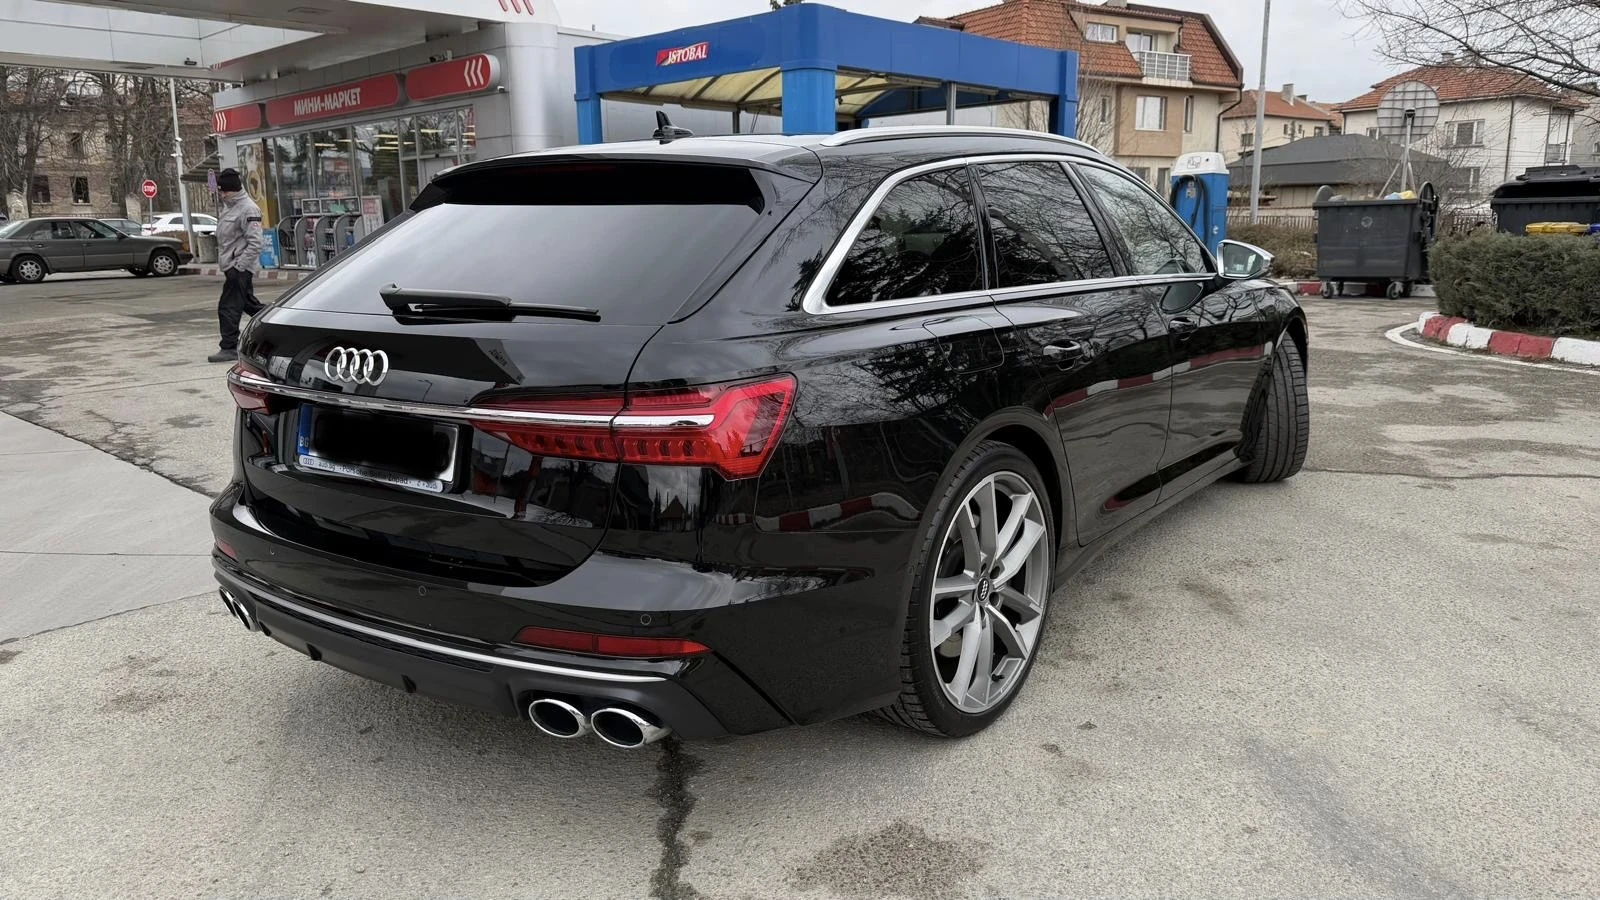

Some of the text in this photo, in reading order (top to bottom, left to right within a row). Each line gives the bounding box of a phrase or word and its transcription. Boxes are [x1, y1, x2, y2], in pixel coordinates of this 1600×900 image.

[294, 87, 361, 116] МИНИ-МАРКЕТ
[299, 436, 310, 448] BG
[387, 473, 408, 485] Zapad
